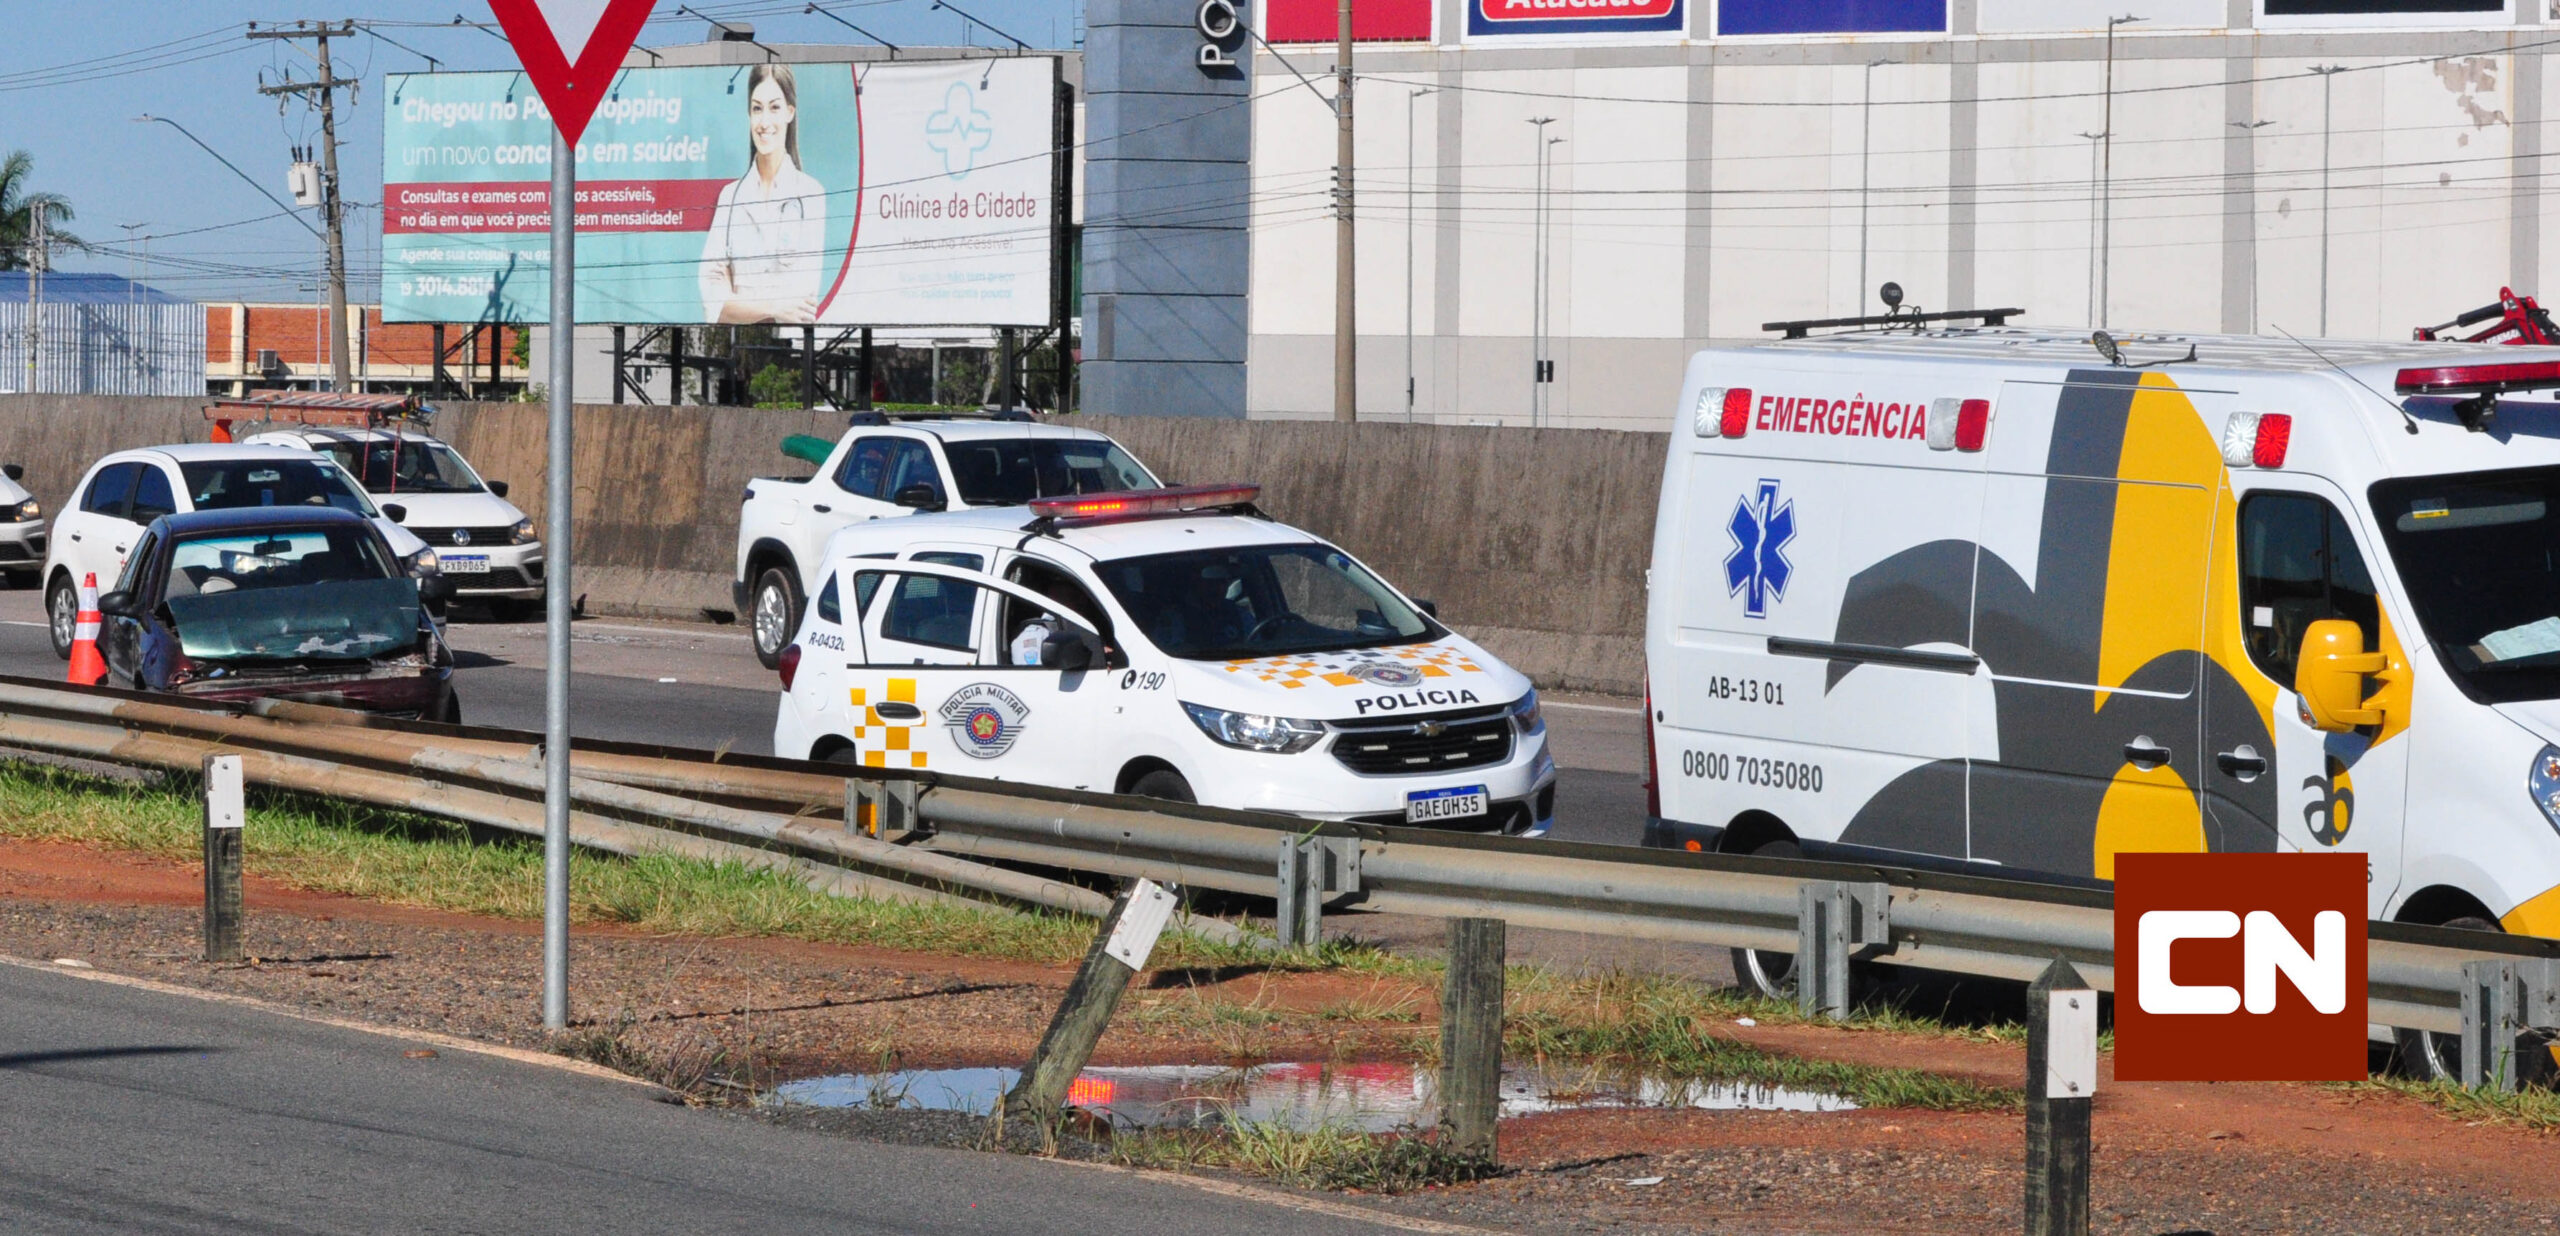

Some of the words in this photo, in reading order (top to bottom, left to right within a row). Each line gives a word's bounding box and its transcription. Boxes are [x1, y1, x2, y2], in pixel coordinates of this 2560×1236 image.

[402, 96, 485, 128] Chegou
[488, 100, 517, 121] no
[522, 95, 552, 121] Po
[402, 146, 436, 166] um
[442, 146, 490, 165] novo
[593, 141, 628, 163] em
[632, 135, 709, 163] saúde!
[400, 189, 460, 204] Consultas
[461, 191, 470, 203] e
[471, 191, 517, 203] exames
[519, 190, 546, 203] com
[591, 186, 656, 204] acessíveis,
[879, 192, 942, 219] Clínica
[947, 192, 969, 218] da
[975, 191, 1037, 218] Cidade
[400, 214, 417, 227] no
[418, 212, 437, 226] dia
[439, 214, 459, 227] em
[461, 214, 484, 229] que
[486, 211, 514, 226] você
[574, 213, 599, 226] sem
[601, 210, 683, 226] mensalidade!
[400, 248, 444, 264] Agende
[518, 250, 533, 261] ou
[1755, 392, 1926, 441] EMERGÊNCIA
[1137, 671, 1166, 691] 190
[1708, 675, 1758, 703] AB-13
[1764, 681, 1784, 706] 01
[986, 686, 1024, 716] MILITAR
[1354, 688, 1480, 715] POLÍCIA
[1683, 749, 1729, 781] 0800
[1736, 755, 1823, 793] 7035080
